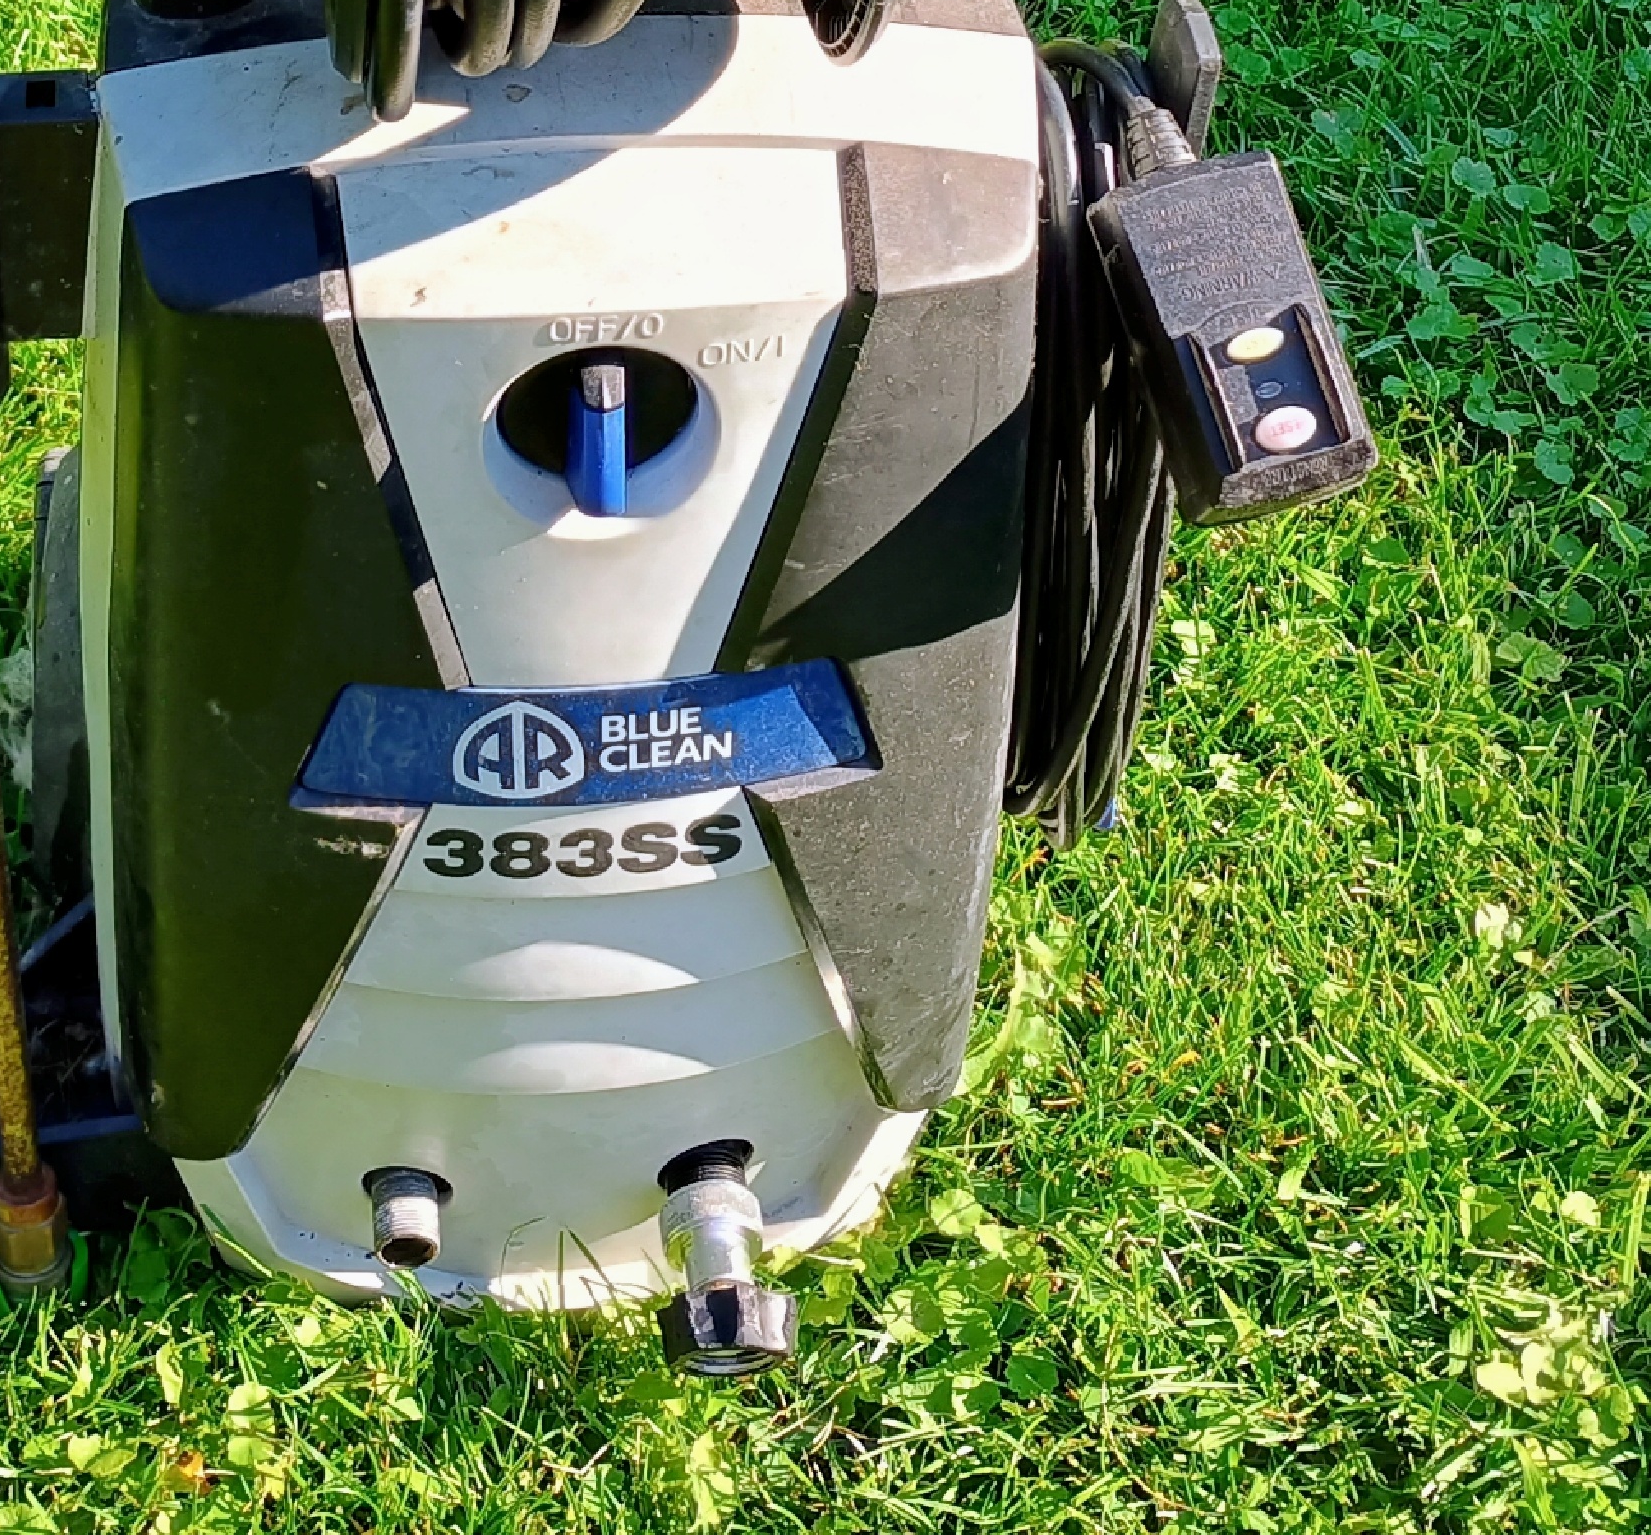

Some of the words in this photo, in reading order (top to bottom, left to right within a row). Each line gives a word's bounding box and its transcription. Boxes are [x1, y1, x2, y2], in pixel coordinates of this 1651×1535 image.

[461, 711, 575, 790] AR
[598, 730, 734, 773] CLEAN
[600, 706, 702, 743] BLUE
[422, 813, 743, 879] 383SS
